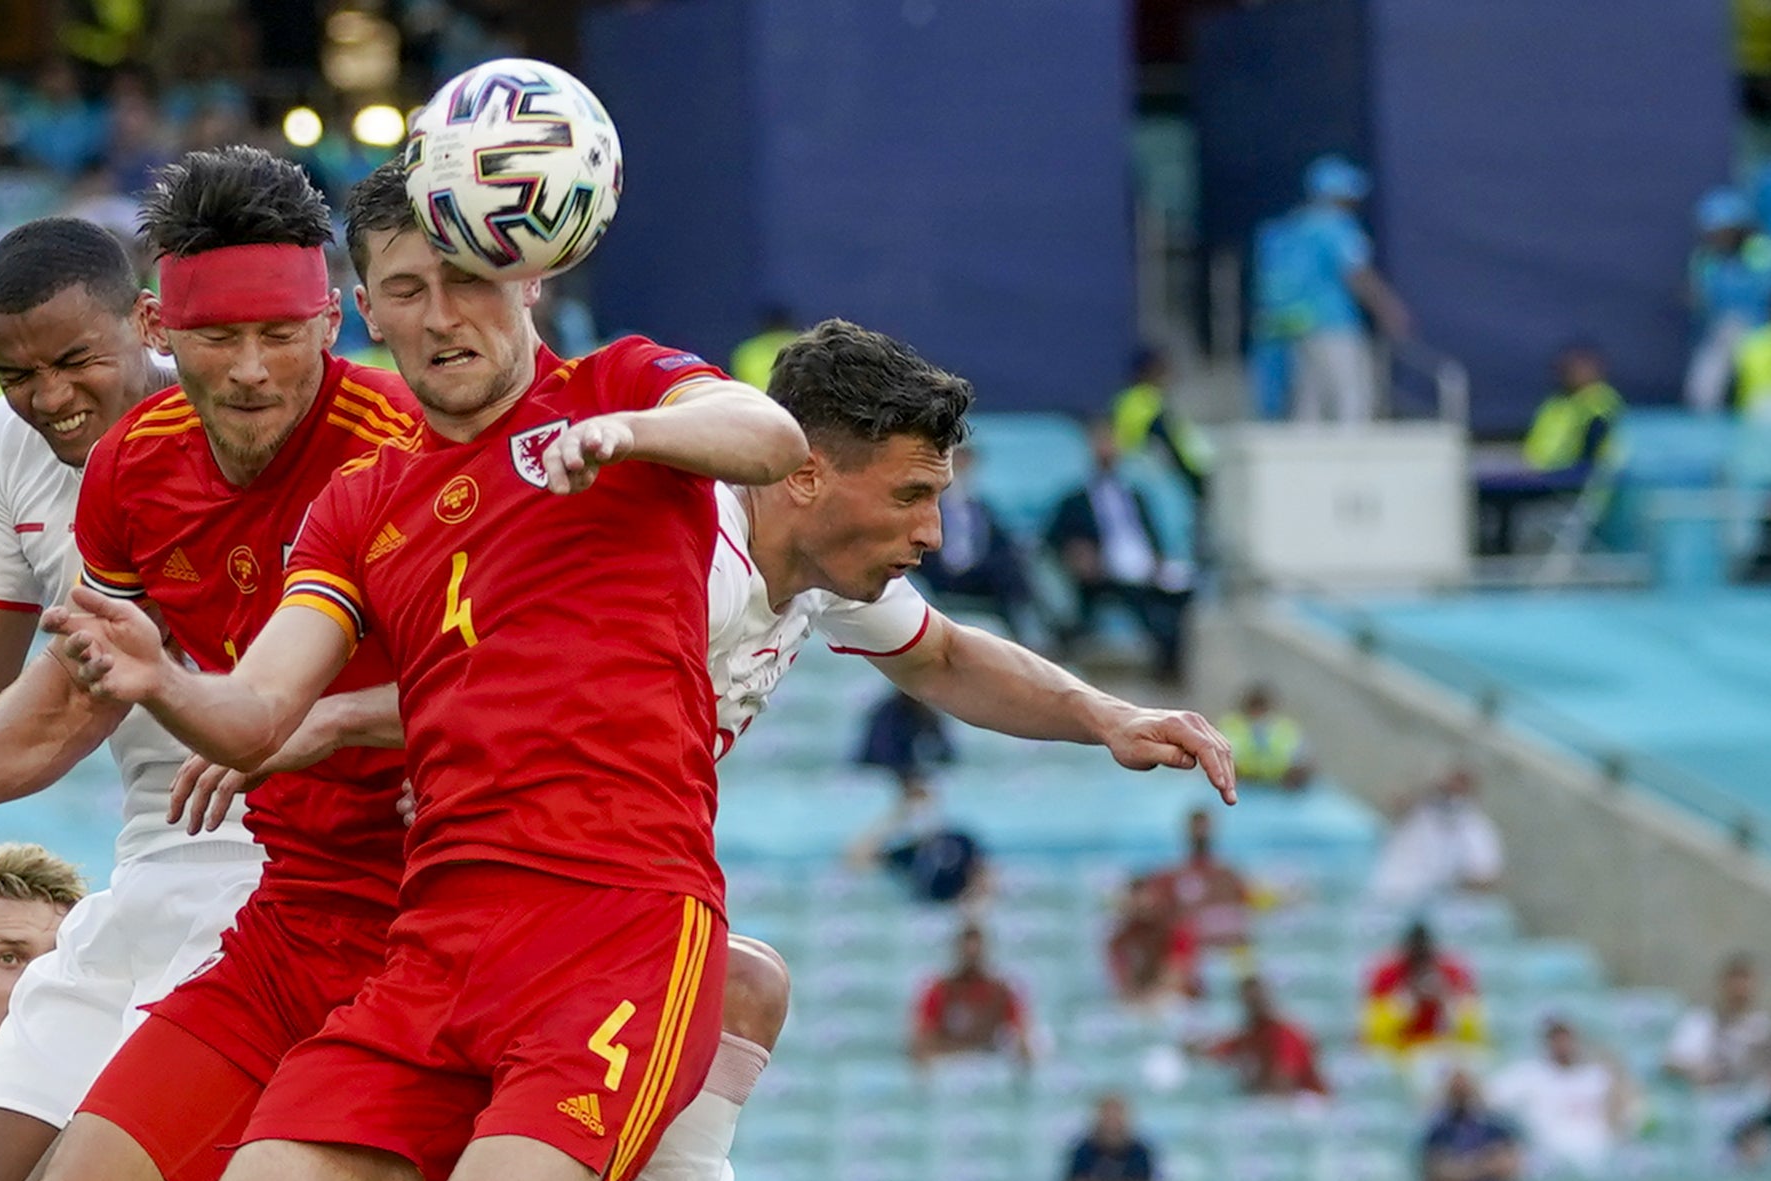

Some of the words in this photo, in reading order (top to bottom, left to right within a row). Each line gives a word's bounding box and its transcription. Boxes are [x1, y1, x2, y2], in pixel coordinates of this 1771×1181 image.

[441, 551, 479, 648] 4
[588, 999, 637, 1092] 4
[556, 1101, 606, 1136] adidas
